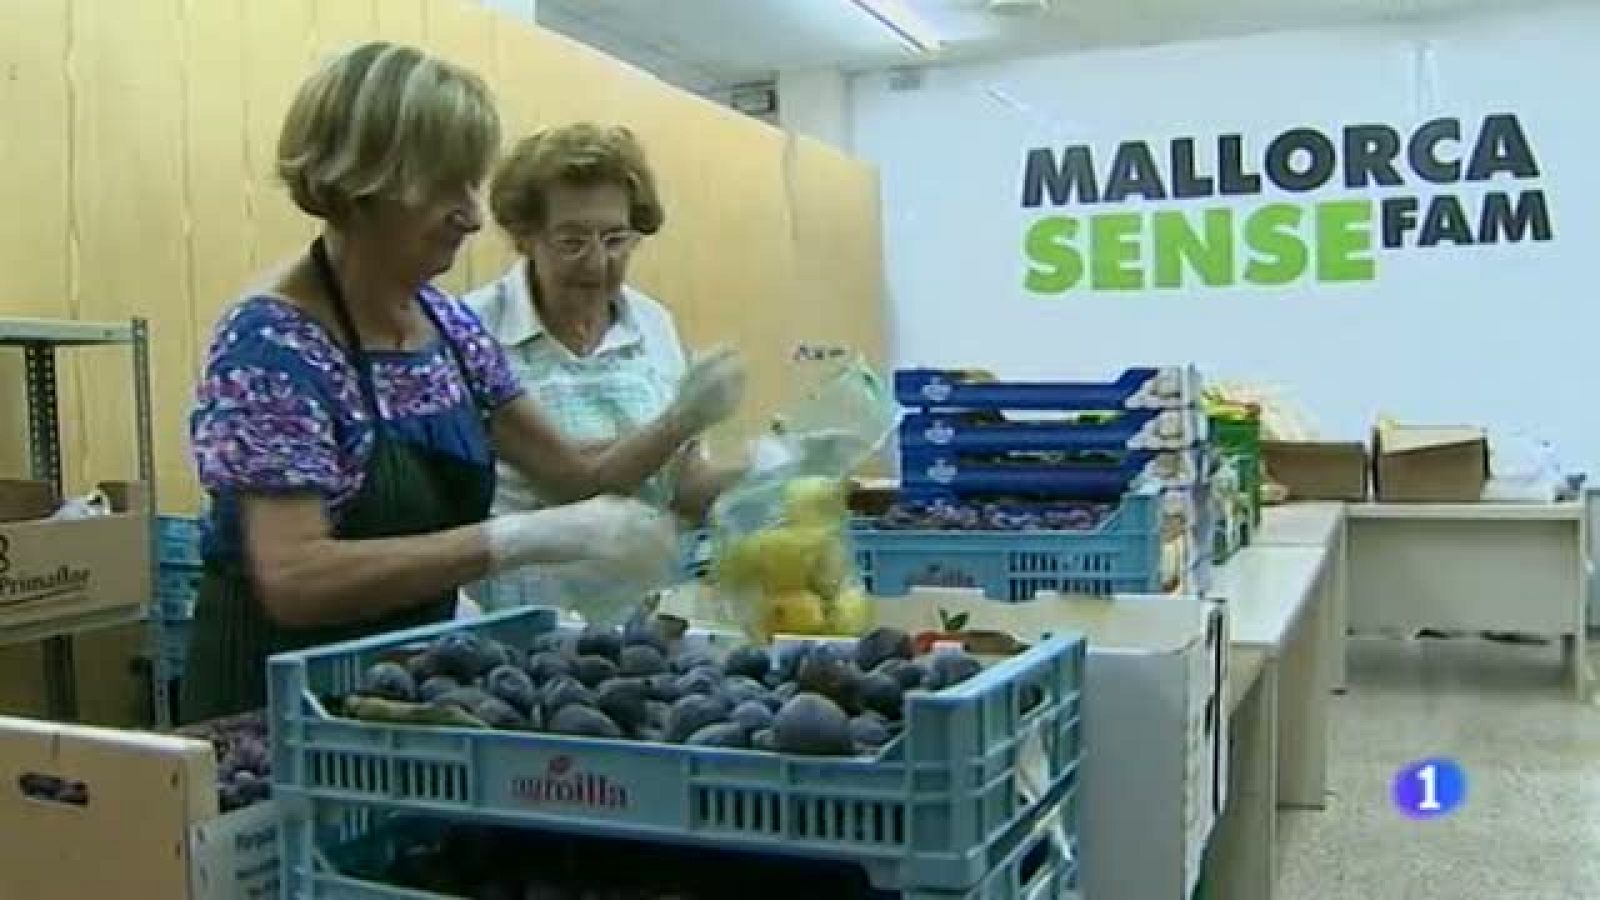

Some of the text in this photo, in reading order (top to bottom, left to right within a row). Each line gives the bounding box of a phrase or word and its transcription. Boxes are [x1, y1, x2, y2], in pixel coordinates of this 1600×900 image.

[1021, 113, 1540, 208] MALLORCA
[1023, 190, 1553, 295] SENSE FAM
